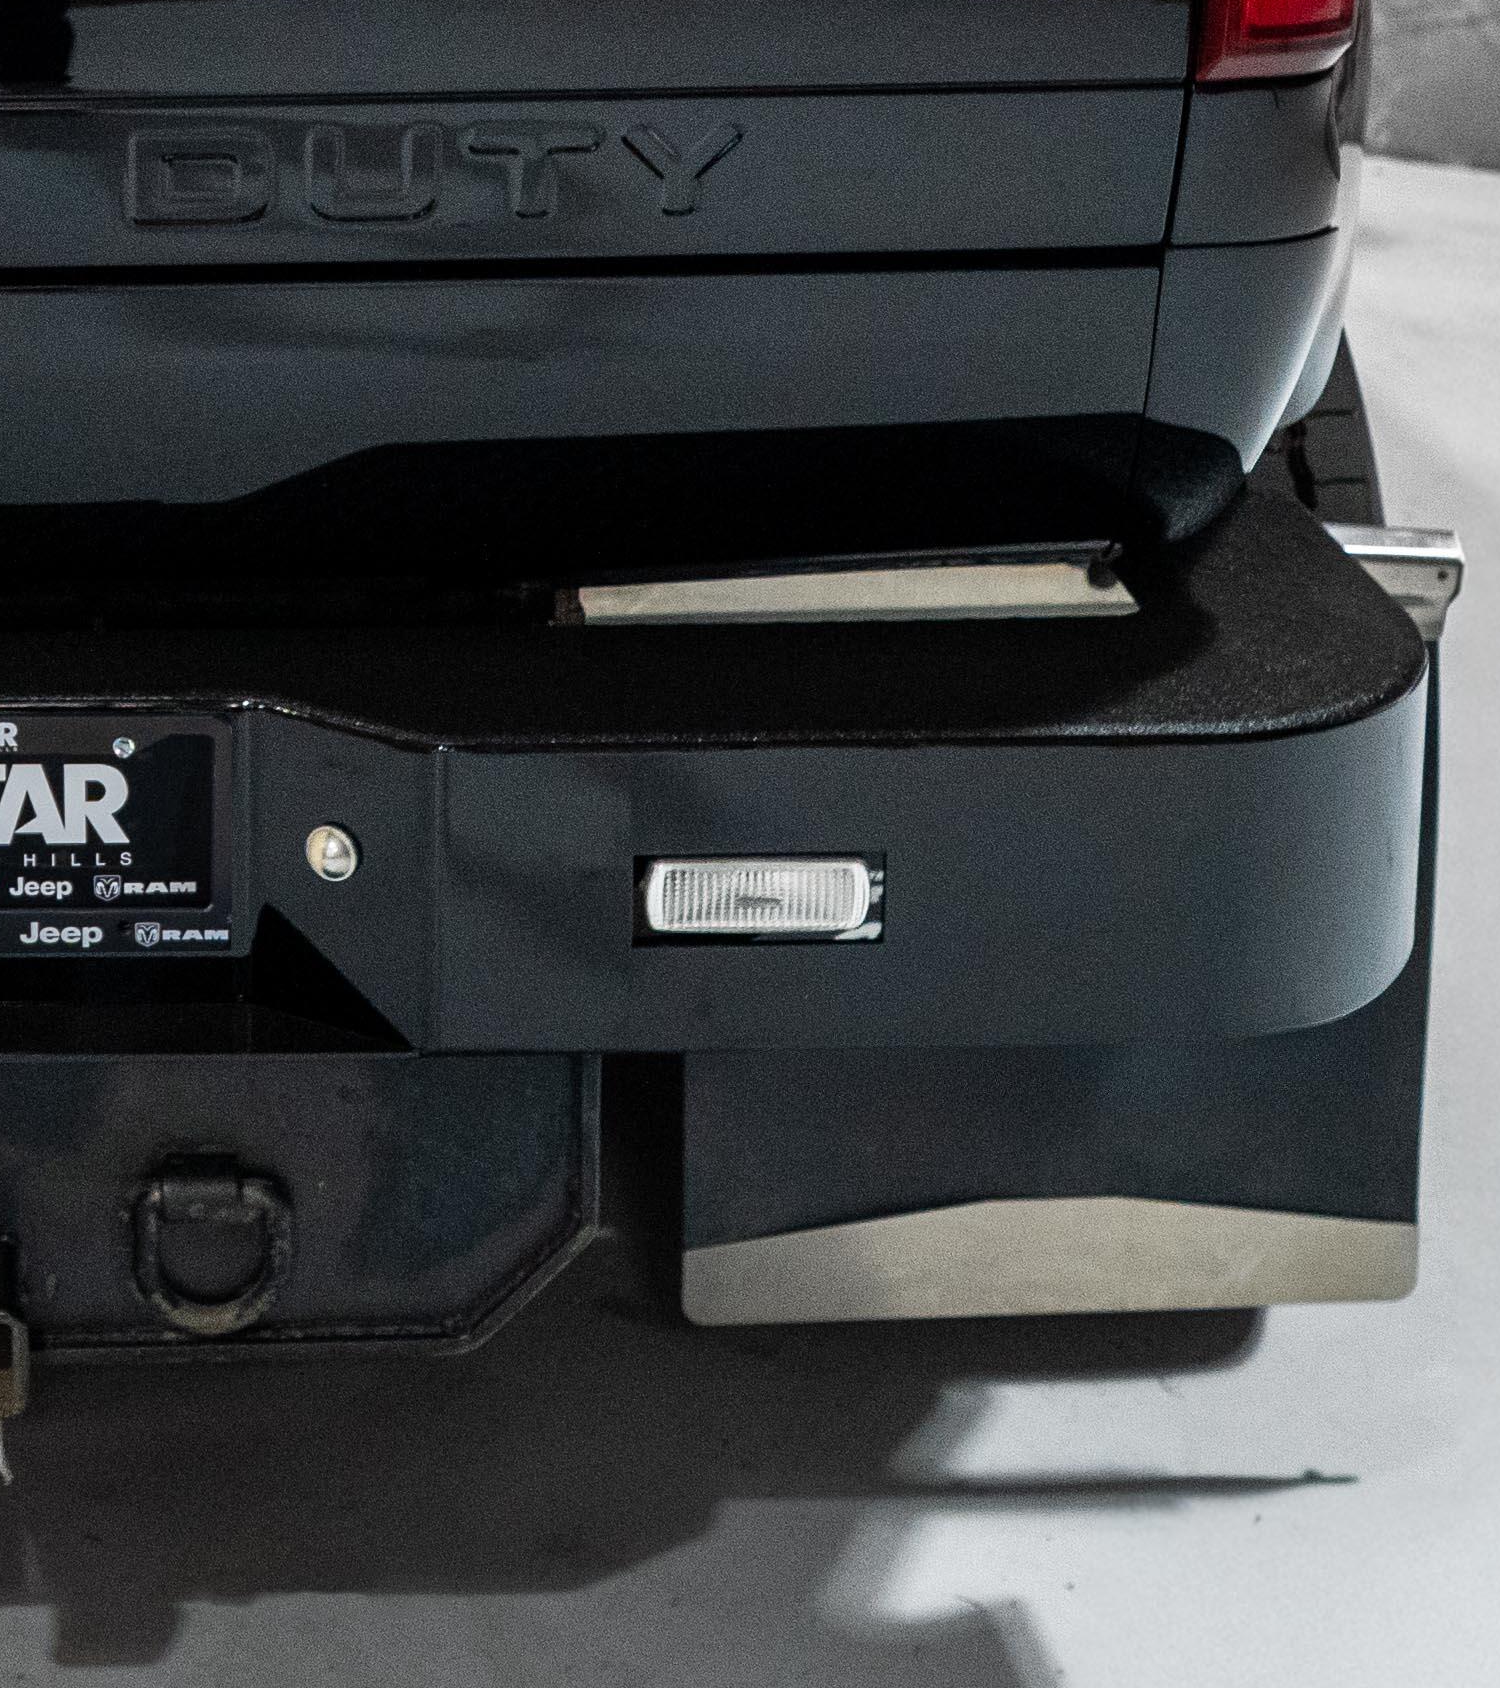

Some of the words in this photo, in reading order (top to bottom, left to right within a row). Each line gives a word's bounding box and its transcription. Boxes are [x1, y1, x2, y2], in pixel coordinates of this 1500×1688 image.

[124, 120, 746, 228] DUTY
[22, 851, 133, 868] HILLS
[8, 876, 73, 900] Jeep
[123, 881, 197, 895] RAM
[19, 921, 103, 948] Jeep
[162, 929, 230, 941] RAM
